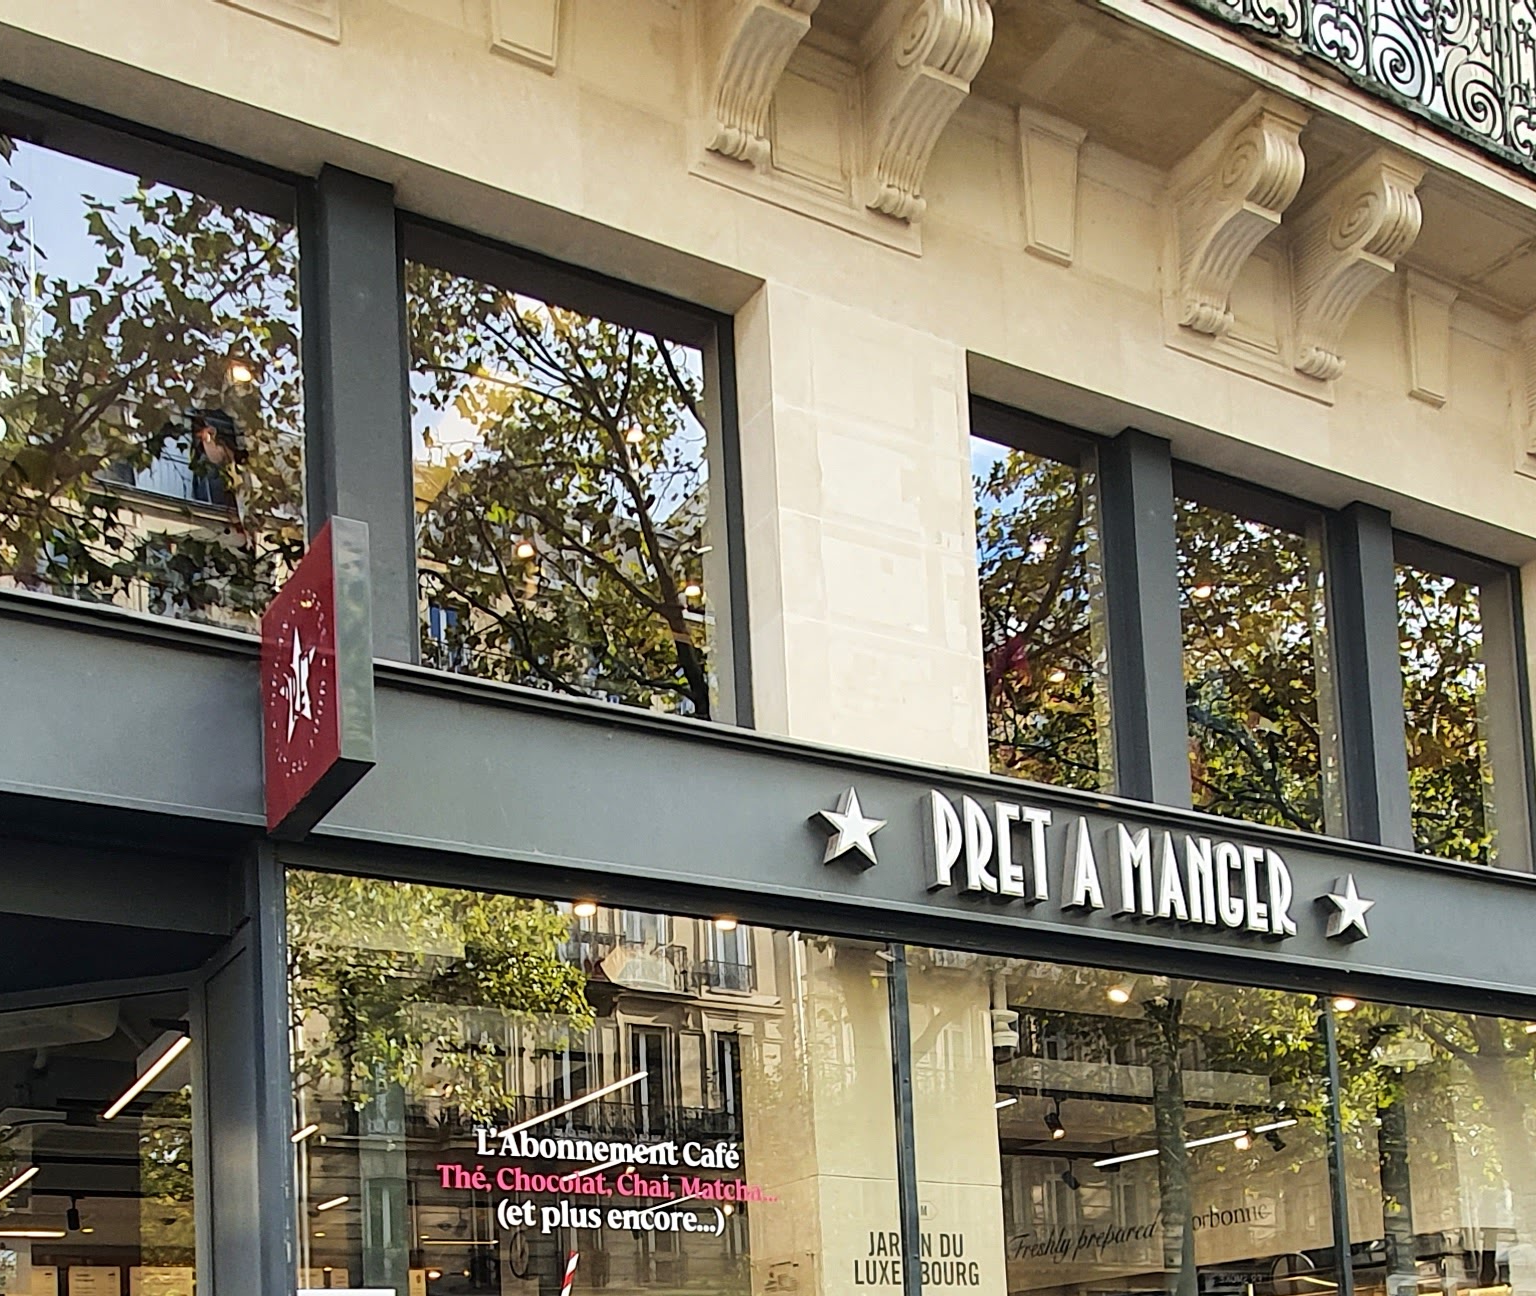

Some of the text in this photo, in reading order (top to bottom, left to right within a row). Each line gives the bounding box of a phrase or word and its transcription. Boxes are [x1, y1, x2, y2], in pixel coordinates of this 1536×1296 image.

[928, 788, 1297, 937] PRET A MANGER
[476, 1128, 740, 1169] L'Abonnement Café
[437, 1164, 493, 1192] Thé,
[496, 1166, 613, 1197] Chocolat,
[616, 1171, 676, 1200] Chai,
[496, 1198, 726, 1237] (et plus encore...)
[1011, 1228, 1073, 1264] Freshly
[1073, 1208, 1161, 1261] prepared
[868, 1231, 964, 1258] JARN DU
[854, 1259, 980, 1286] LUXEBOURG
